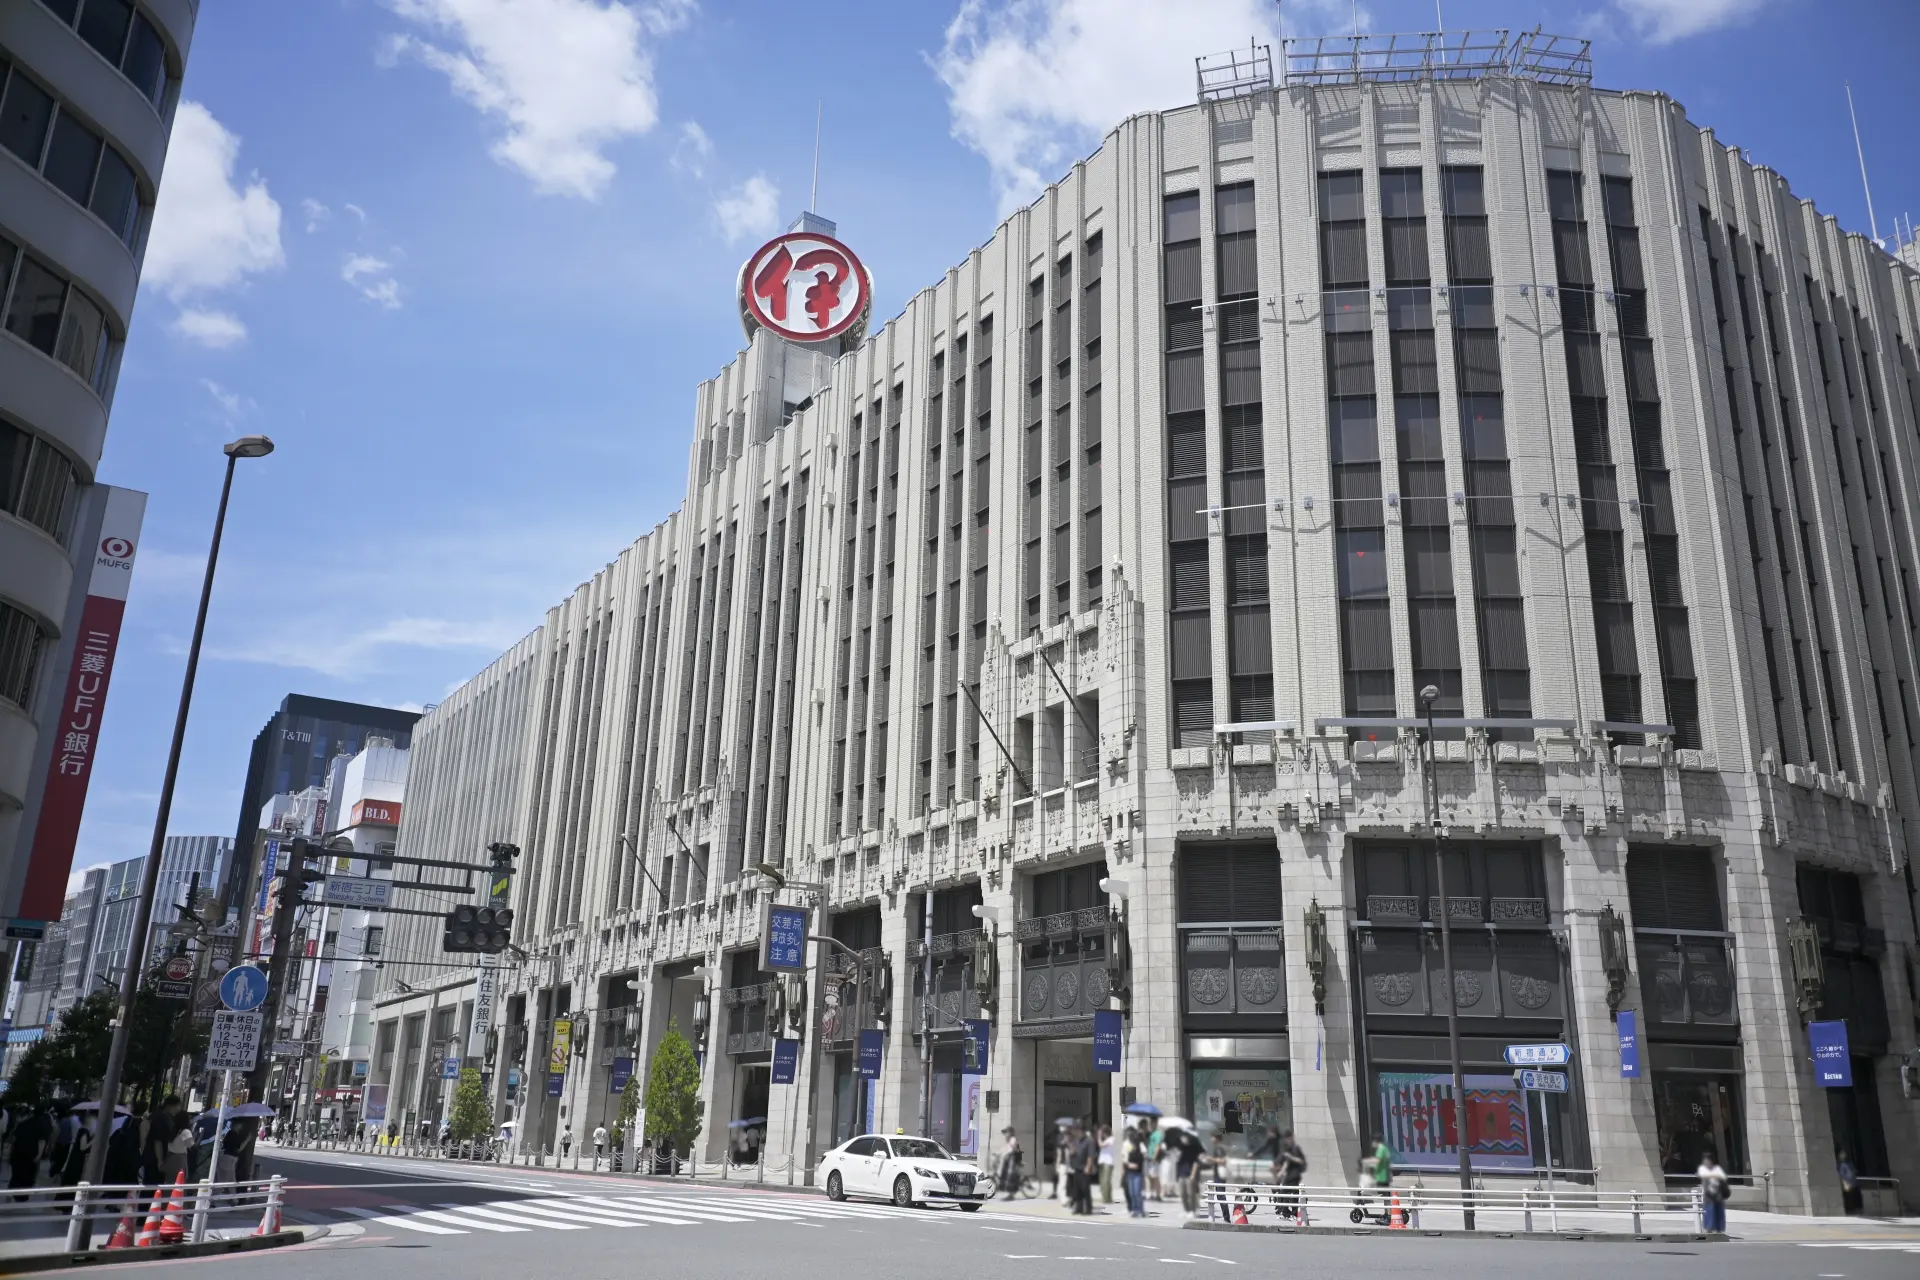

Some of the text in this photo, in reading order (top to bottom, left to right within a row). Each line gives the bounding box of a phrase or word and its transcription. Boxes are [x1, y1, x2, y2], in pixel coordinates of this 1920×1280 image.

[97, 557, 131, 571] MUFG
[59, 630, 111, 776] 三菱UFJ銀行
[365, 807, 391, 821] BLD.
[329, 880, 386, 896] 新宿三丁目
[327, 892, 385, 903] Shinjuku 3-chome
[771, 915, 802, 931] 交差点
[770, 931, 800, 945] 事故多し
[213, 947, 233, 956] NO!
[770, 946, 798, 962] 注意
[474, 954, 496, 1034] 三井住友銀行
[1514, 1047, 1558, 1057] 新宿通り
[1536, 1073, 1562, 1084] 明治通り
[1824, 1072, 1843, 1080] ISETAN
[1399, 1089, 1438, 1102] YOU
[1402, 1135, 1442, 1148] YOU
